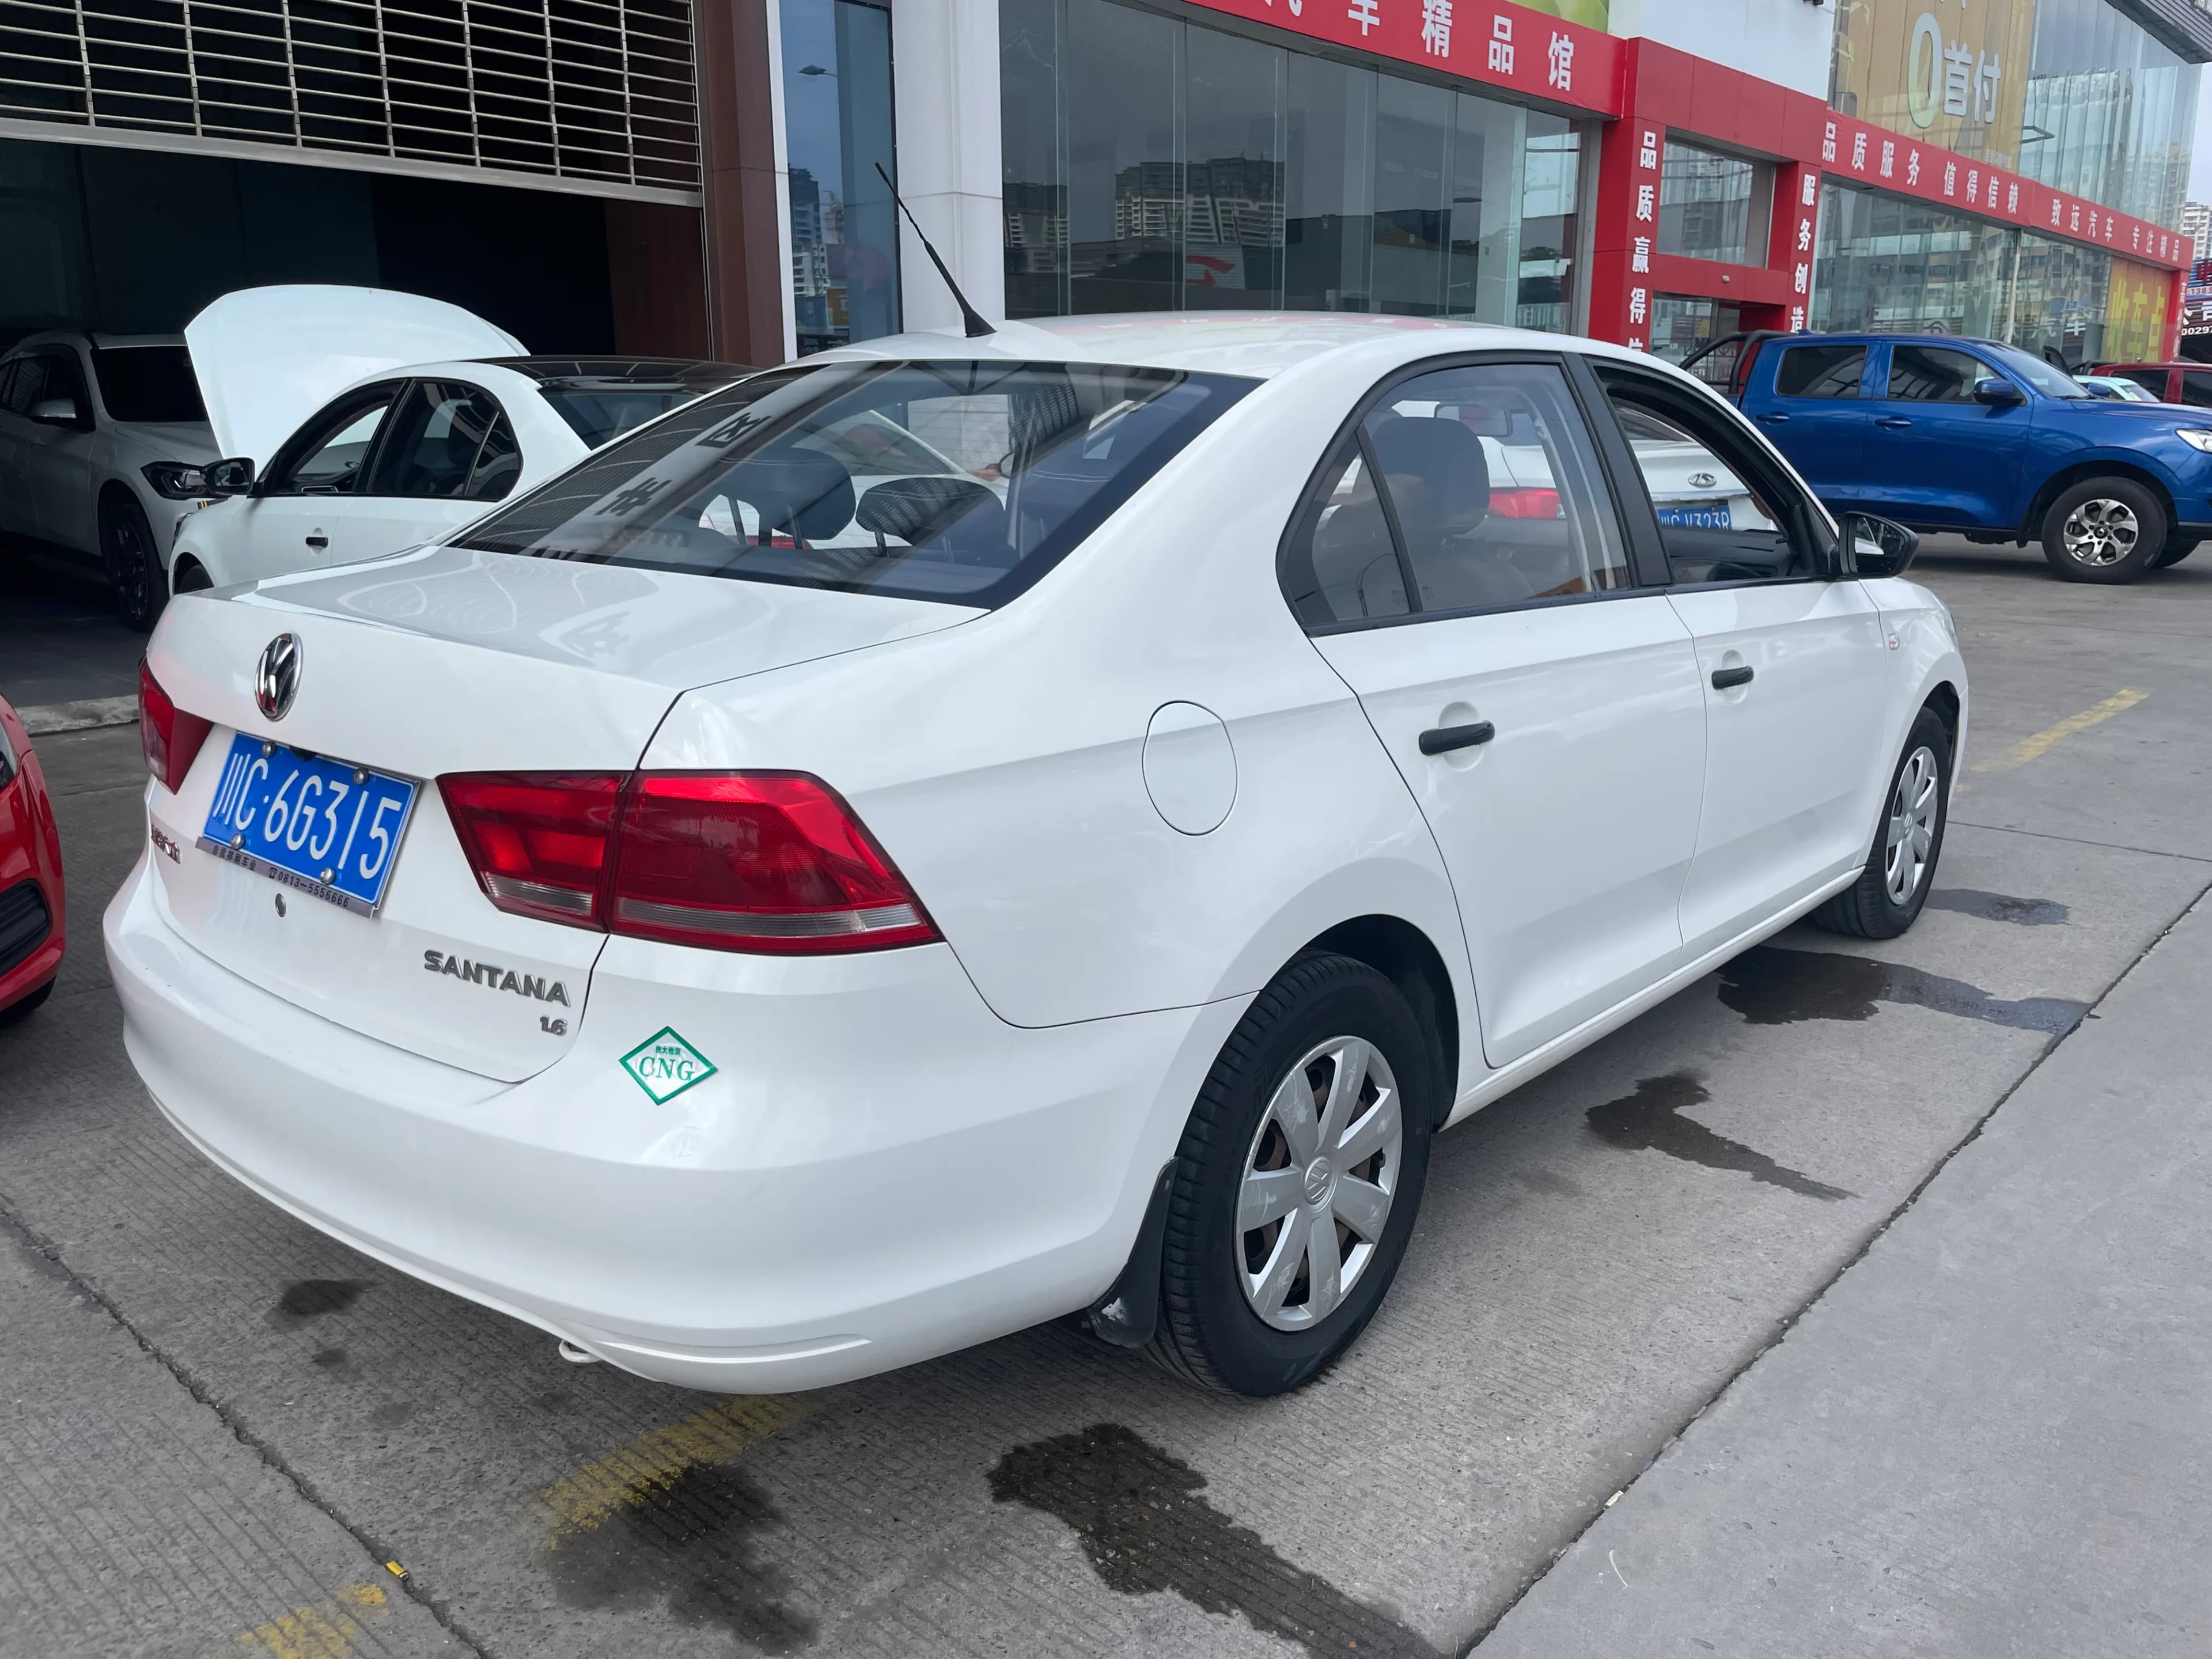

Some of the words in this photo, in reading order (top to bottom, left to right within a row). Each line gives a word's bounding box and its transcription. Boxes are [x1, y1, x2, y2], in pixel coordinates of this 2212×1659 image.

[1266, 0, 1574, 91] 车精品馆
[1822, 122, 1921, 185] 品质服务
[1944, 161, 2018, 214] 值得信赖
[2051, 199, 2114, 243] 致远汽车
[424, 949, 571, 1007] SANTANA
[639, 1055, 695, 1082] CNG
